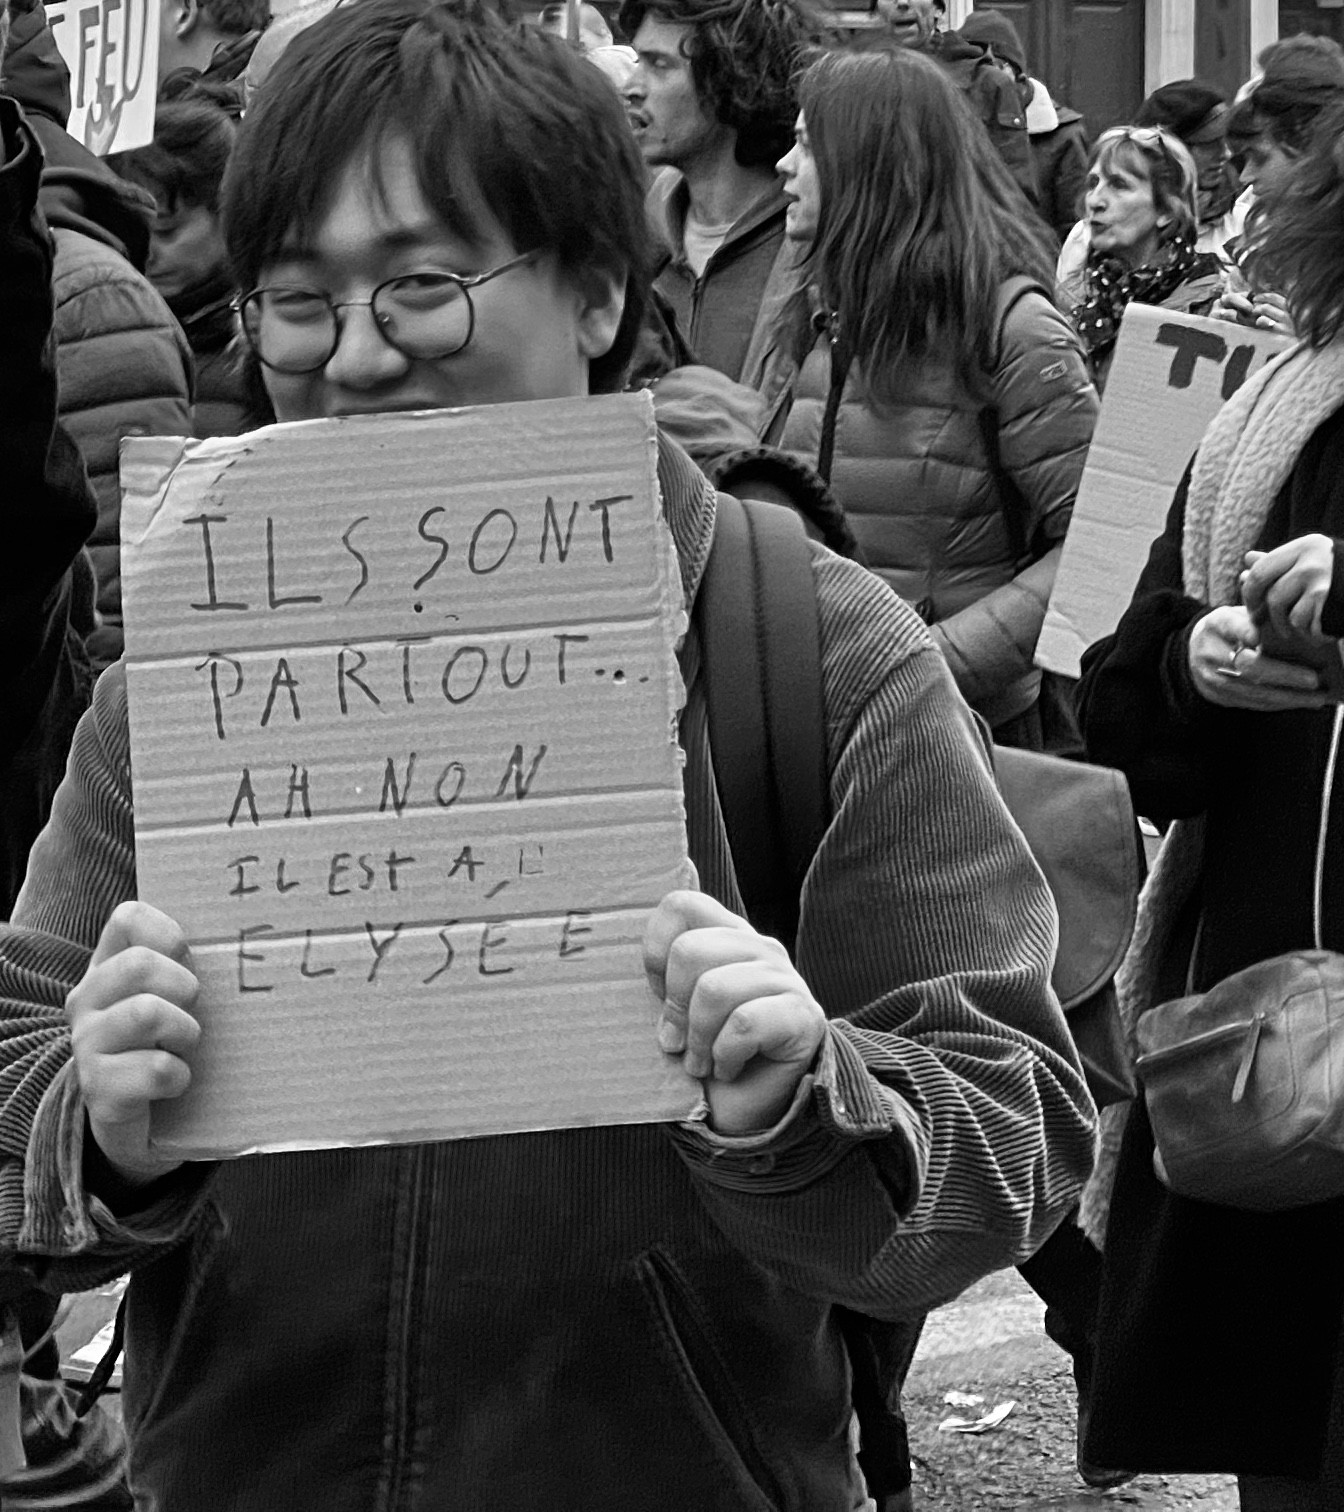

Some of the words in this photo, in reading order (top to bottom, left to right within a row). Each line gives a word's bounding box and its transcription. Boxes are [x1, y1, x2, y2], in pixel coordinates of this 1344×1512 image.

[182, 514, 371, 611] ILS
[413, 494, 635, 591] SONT
[228, 763, 313, 828] AH
[379, 743, 548, 815] NON
[327, 850, 416, 896] EST
